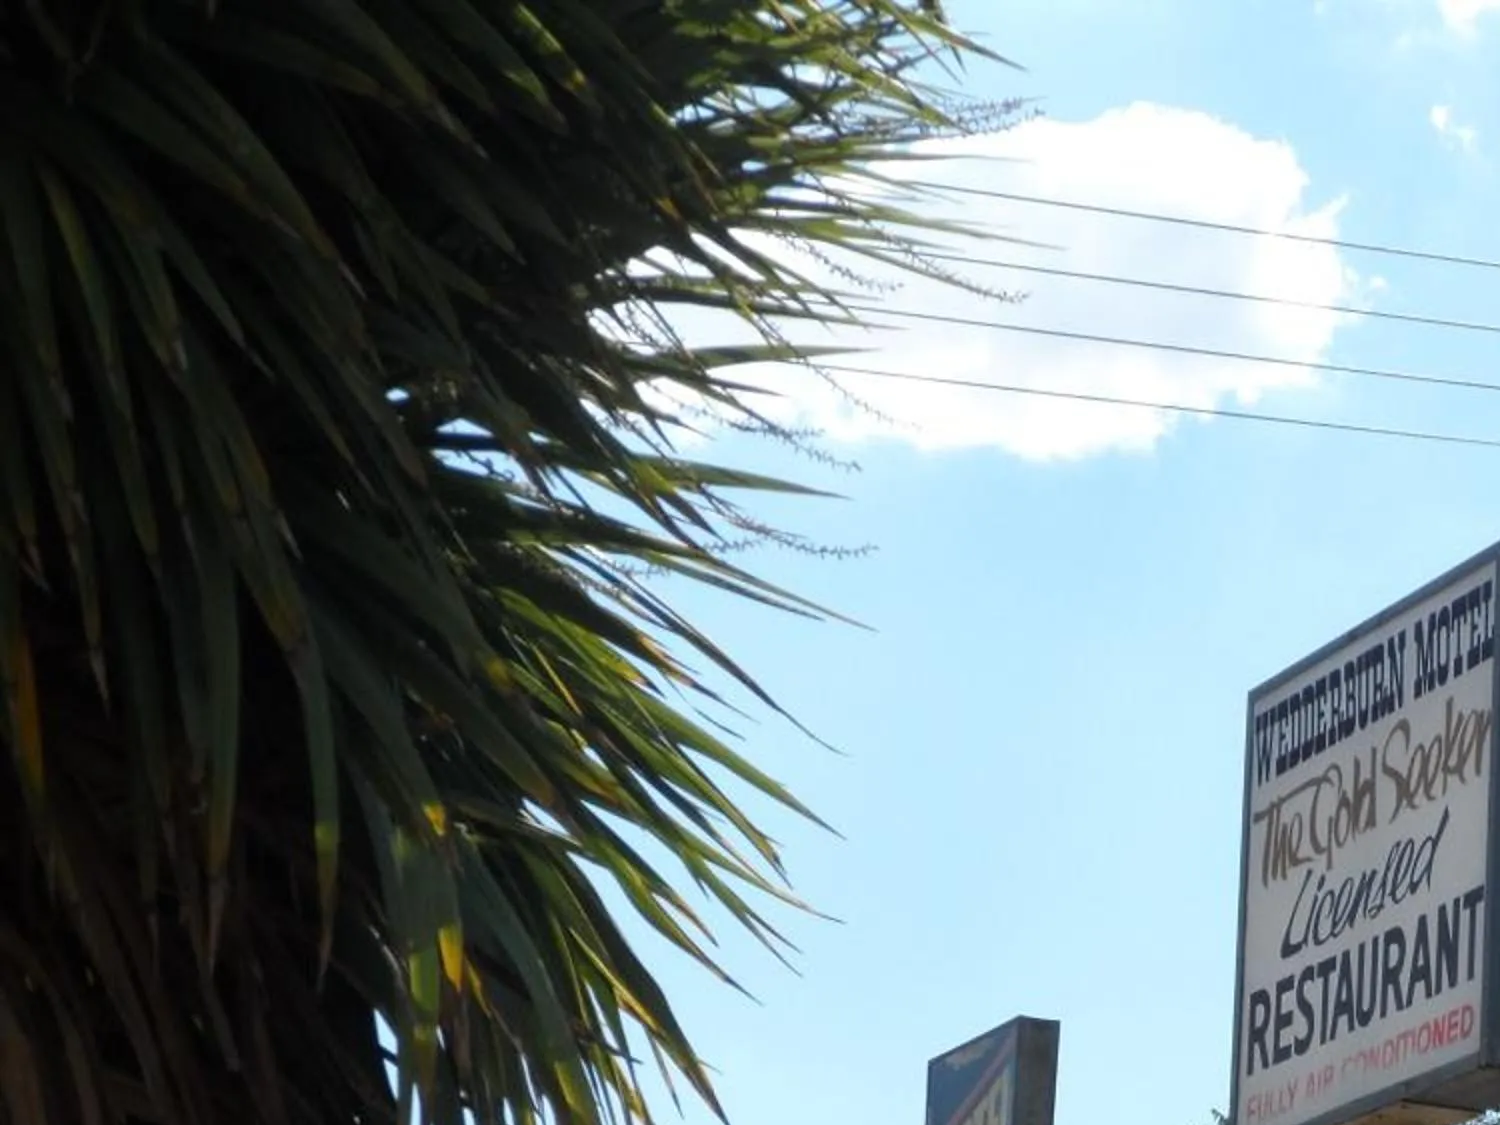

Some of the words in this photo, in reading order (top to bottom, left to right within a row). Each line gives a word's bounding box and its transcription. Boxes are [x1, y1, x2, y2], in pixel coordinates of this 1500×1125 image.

[1254, 628, 1407, 787] WEDDERBURN
[1413, 580, 1495, 699] MOTEL
[1253, 780, 1318, 882] The
[1309, 746, 1378, 870] Gold
[1381, 696, 1491, 824] Seeker
[1280, 804, 1450, 959] Licensed
[1246, 885, 1485, 1077] RESTAURANT
[1246, 1076, 1299, 1125] FULLY
